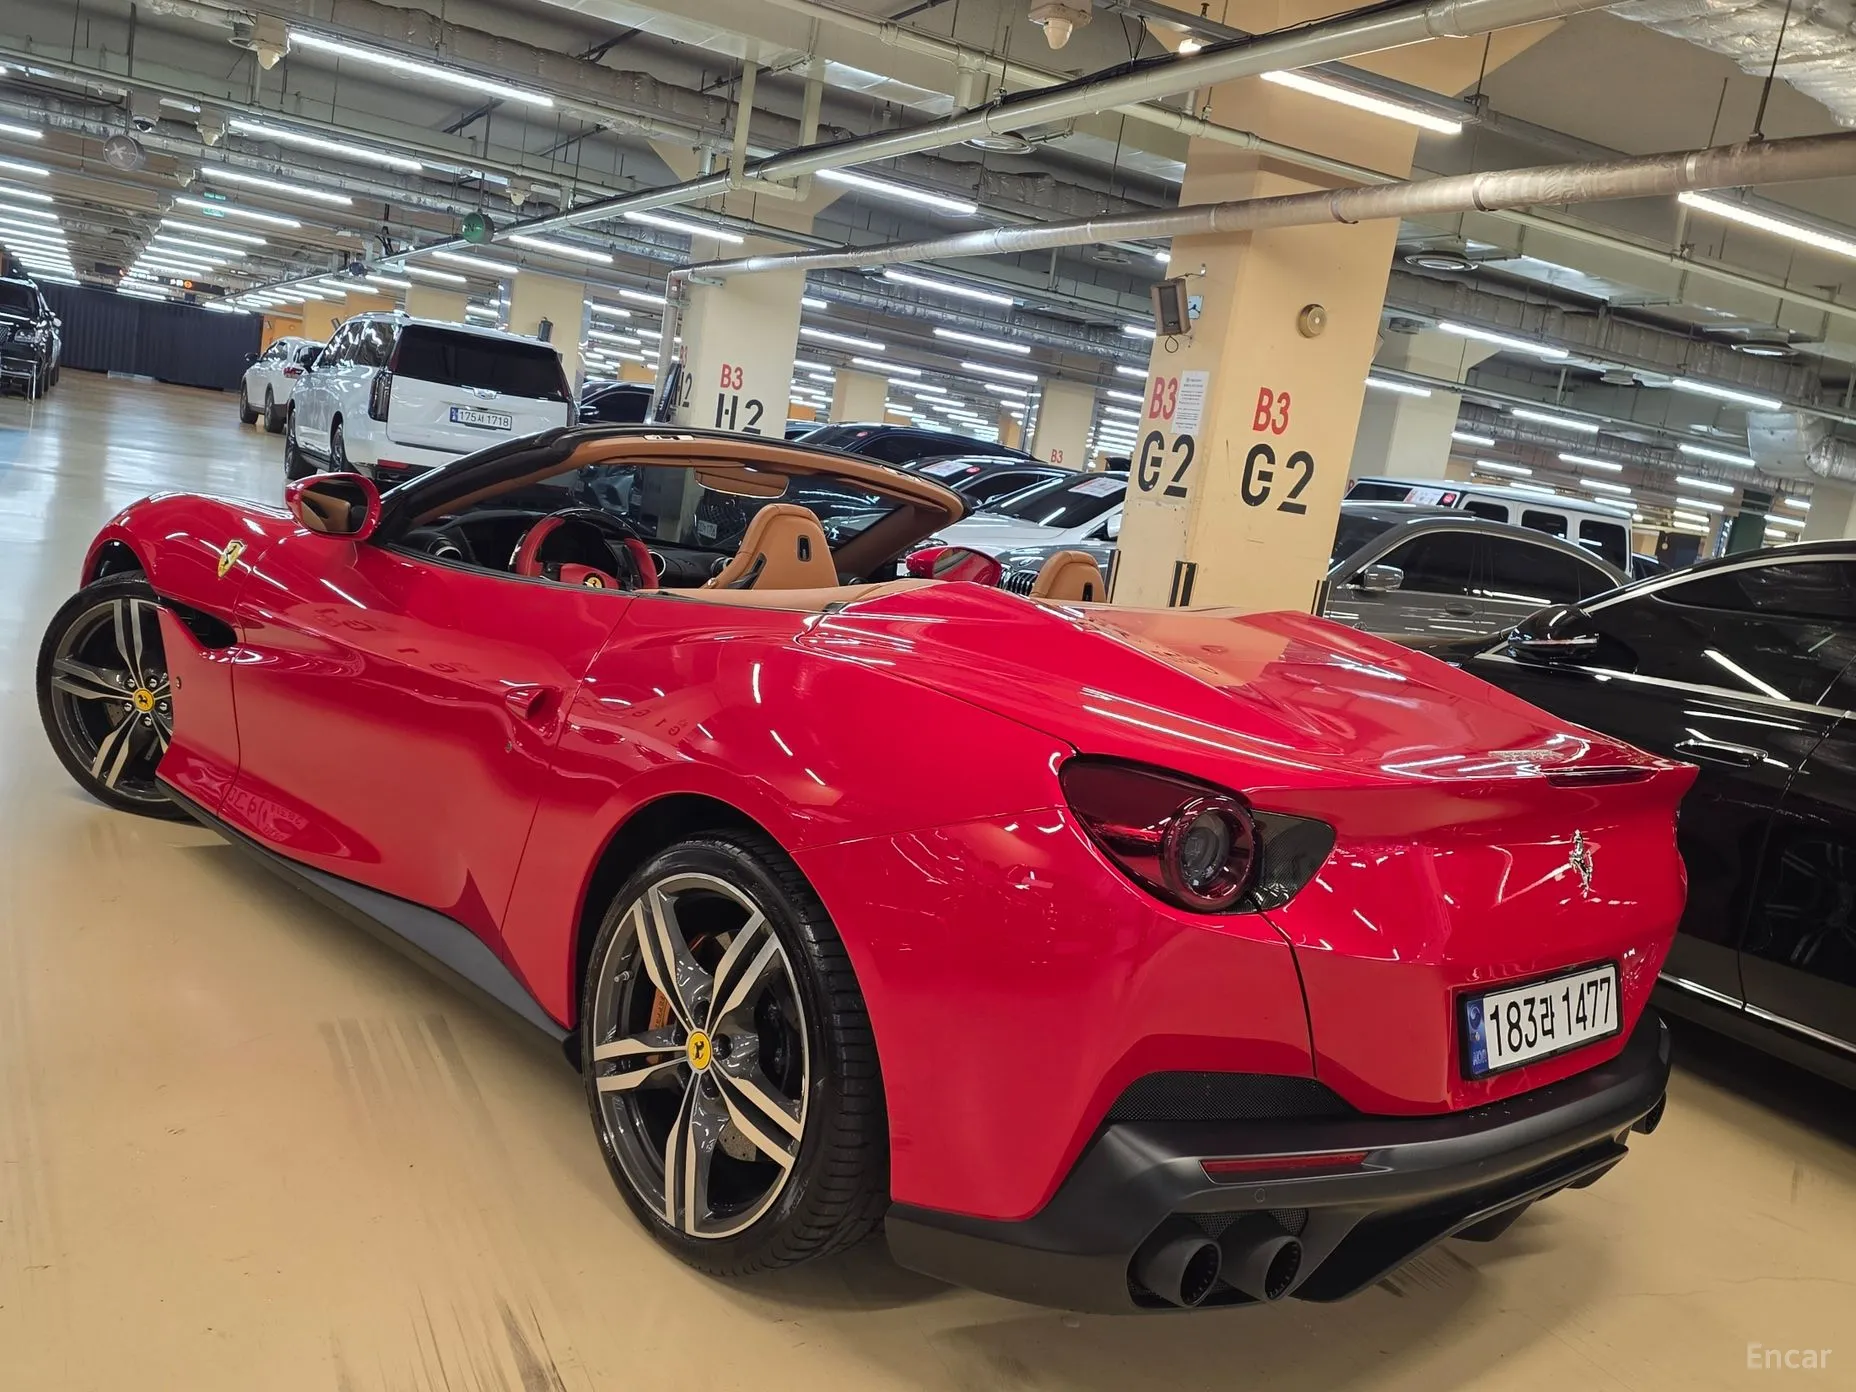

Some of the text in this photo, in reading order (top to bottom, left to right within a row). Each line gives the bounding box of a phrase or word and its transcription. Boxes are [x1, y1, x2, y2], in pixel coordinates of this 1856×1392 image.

[720, 363, 744, 391] B3
[1149, 376, 1178, 421] B3
[487, 415, 509, 427] 1718
[715, 392, 764, 435] H2
[1252, 386, 1291, 435] B3
[1051, 449, 1063, 463] B3
[1138, 430, 1195, 498] G2
[1241, 443, 1315, 515] G2
[1489, 976, 1611, 1057] 183라 1477
